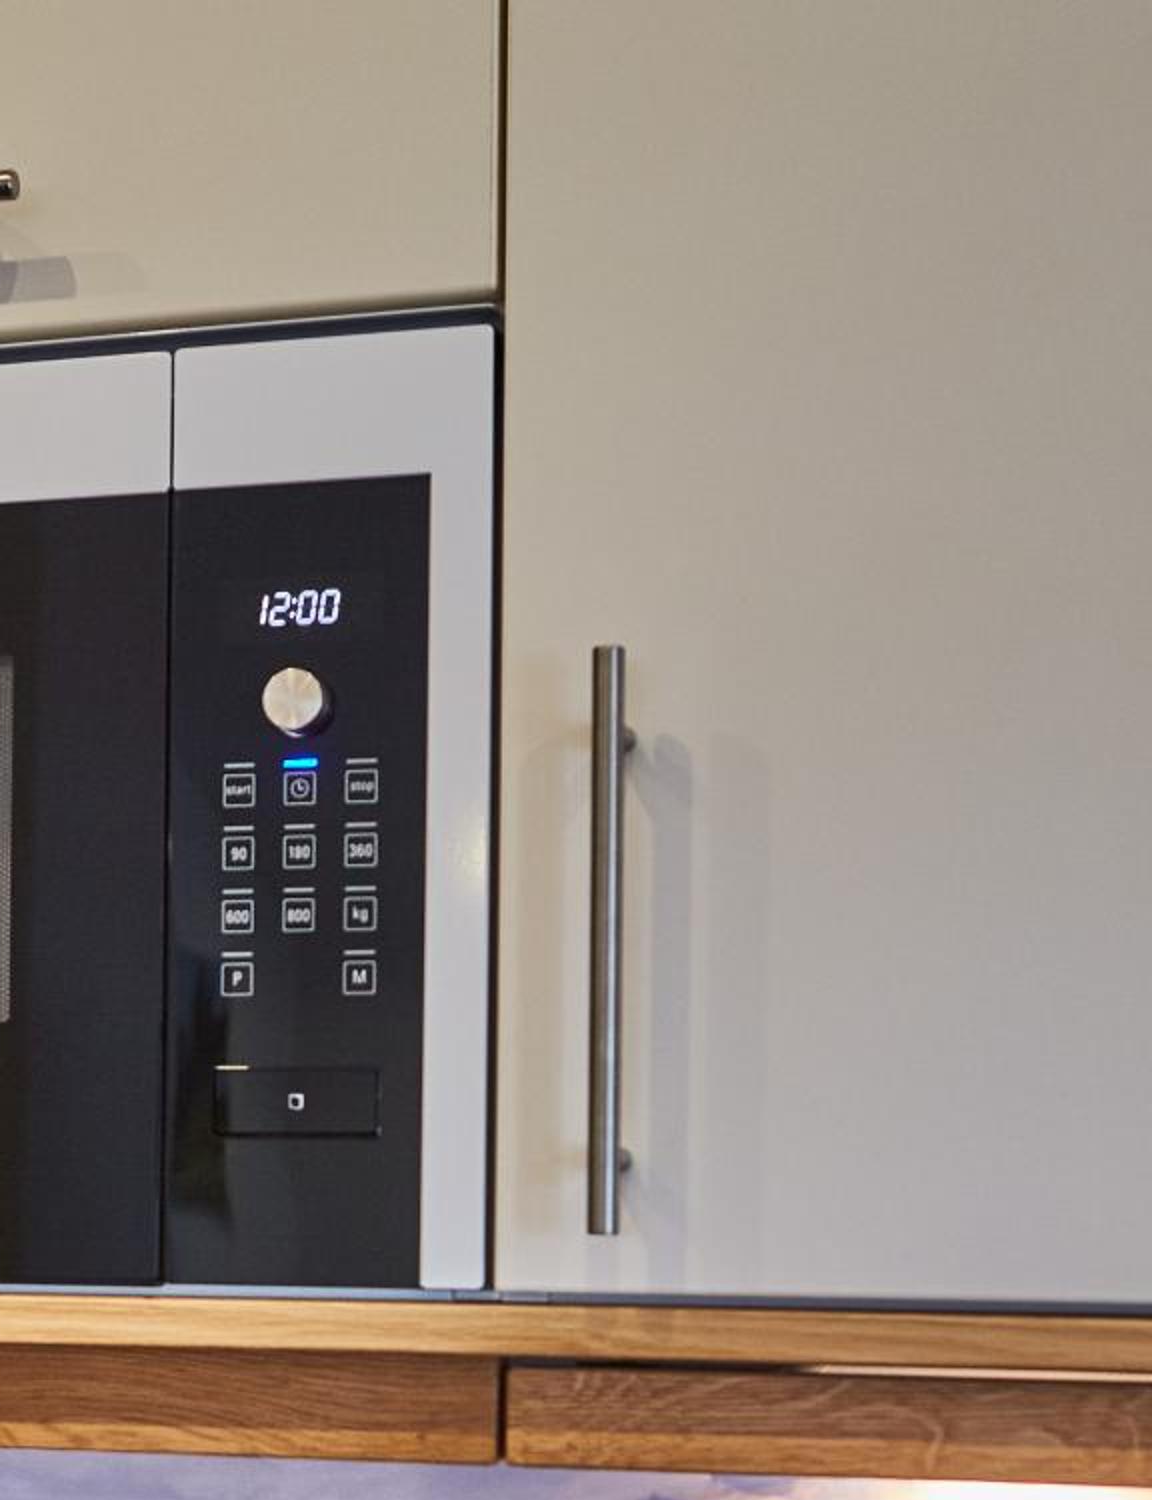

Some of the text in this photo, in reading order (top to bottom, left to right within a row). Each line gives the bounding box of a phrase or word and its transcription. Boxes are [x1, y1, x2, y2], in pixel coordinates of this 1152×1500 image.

[259, 588, 342, 628] 12:00
[230, 846, 248, 861] 90
[349, 842, 374, 859] 360
[352, 906, 369, 923] kg
[232, 970, 243, 986] P
[352, 969, 368, 985] M
